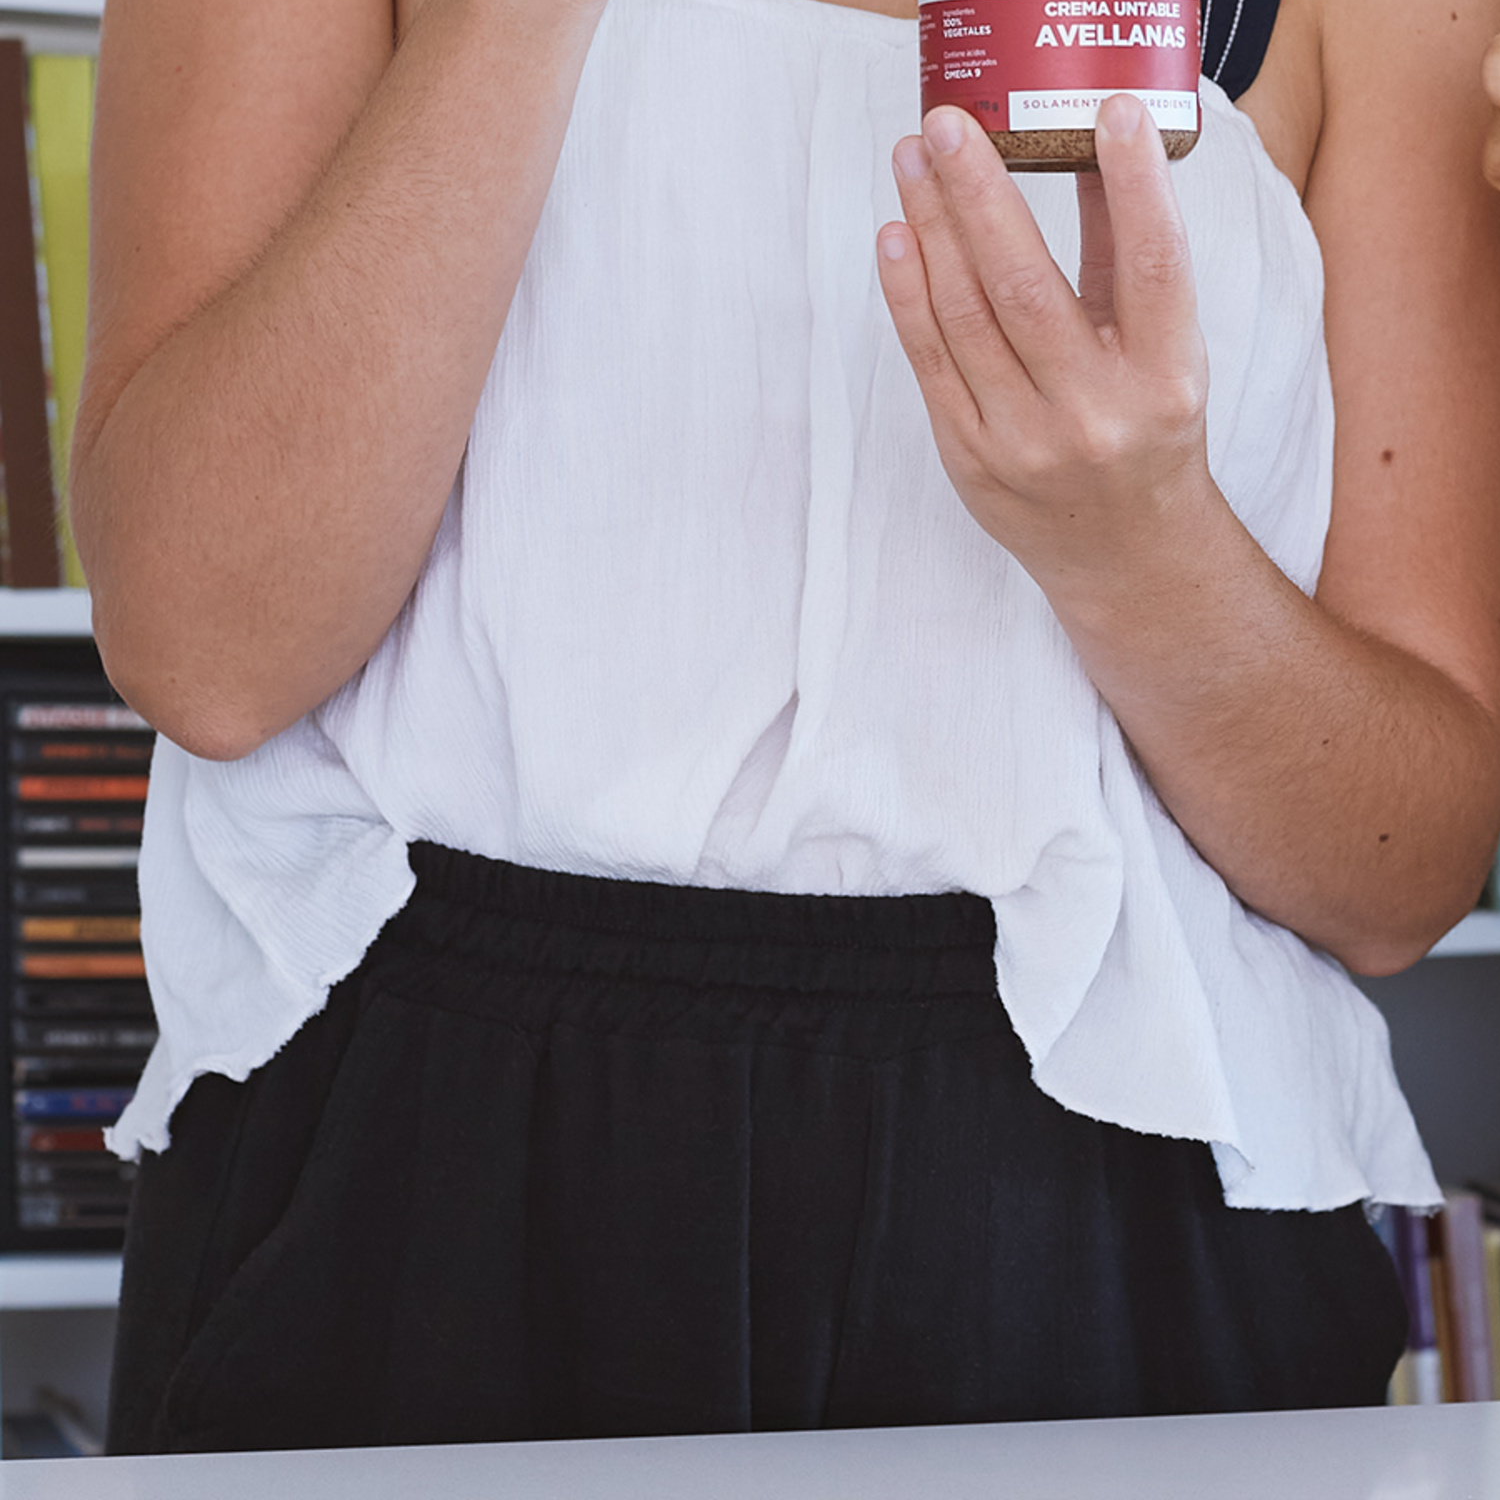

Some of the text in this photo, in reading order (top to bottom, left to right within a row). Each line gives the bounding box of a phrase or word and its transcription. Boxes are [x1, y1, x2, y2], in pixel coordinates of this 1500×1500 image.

[1044, 1, 1181, 18] CREMA UNTABLE
[943, 17, 962, 28] 100%
[943, 25, 992, 38] VEGETALES
[1035, 23, 1186, 49] AVELLANAS
[944, 68, 982, 80] OMEGA 9
